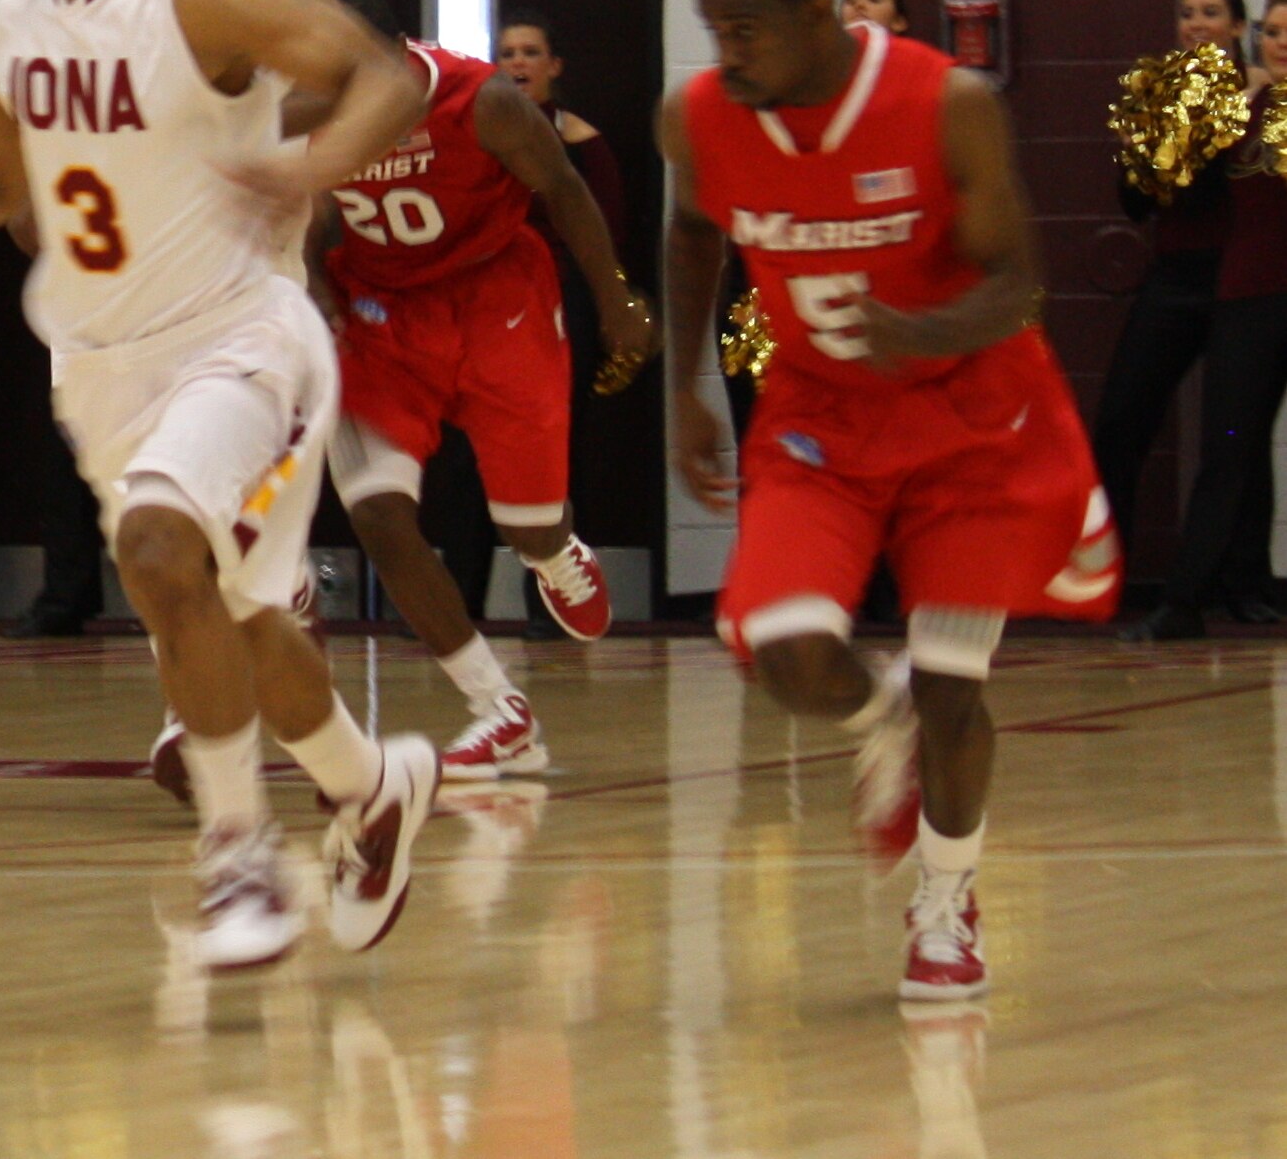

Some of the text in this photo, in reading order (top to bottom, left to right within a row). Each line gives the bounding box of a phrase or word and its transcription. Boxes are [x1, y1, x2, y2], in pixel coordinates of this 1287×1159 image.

[9, 56, 147, 133] IONA
[342, 149, 436, 182] RIST
[53, 163, 131, 274] 3
[331, 188, 445, 246] 20
[784, 271, 874, 361] 5
